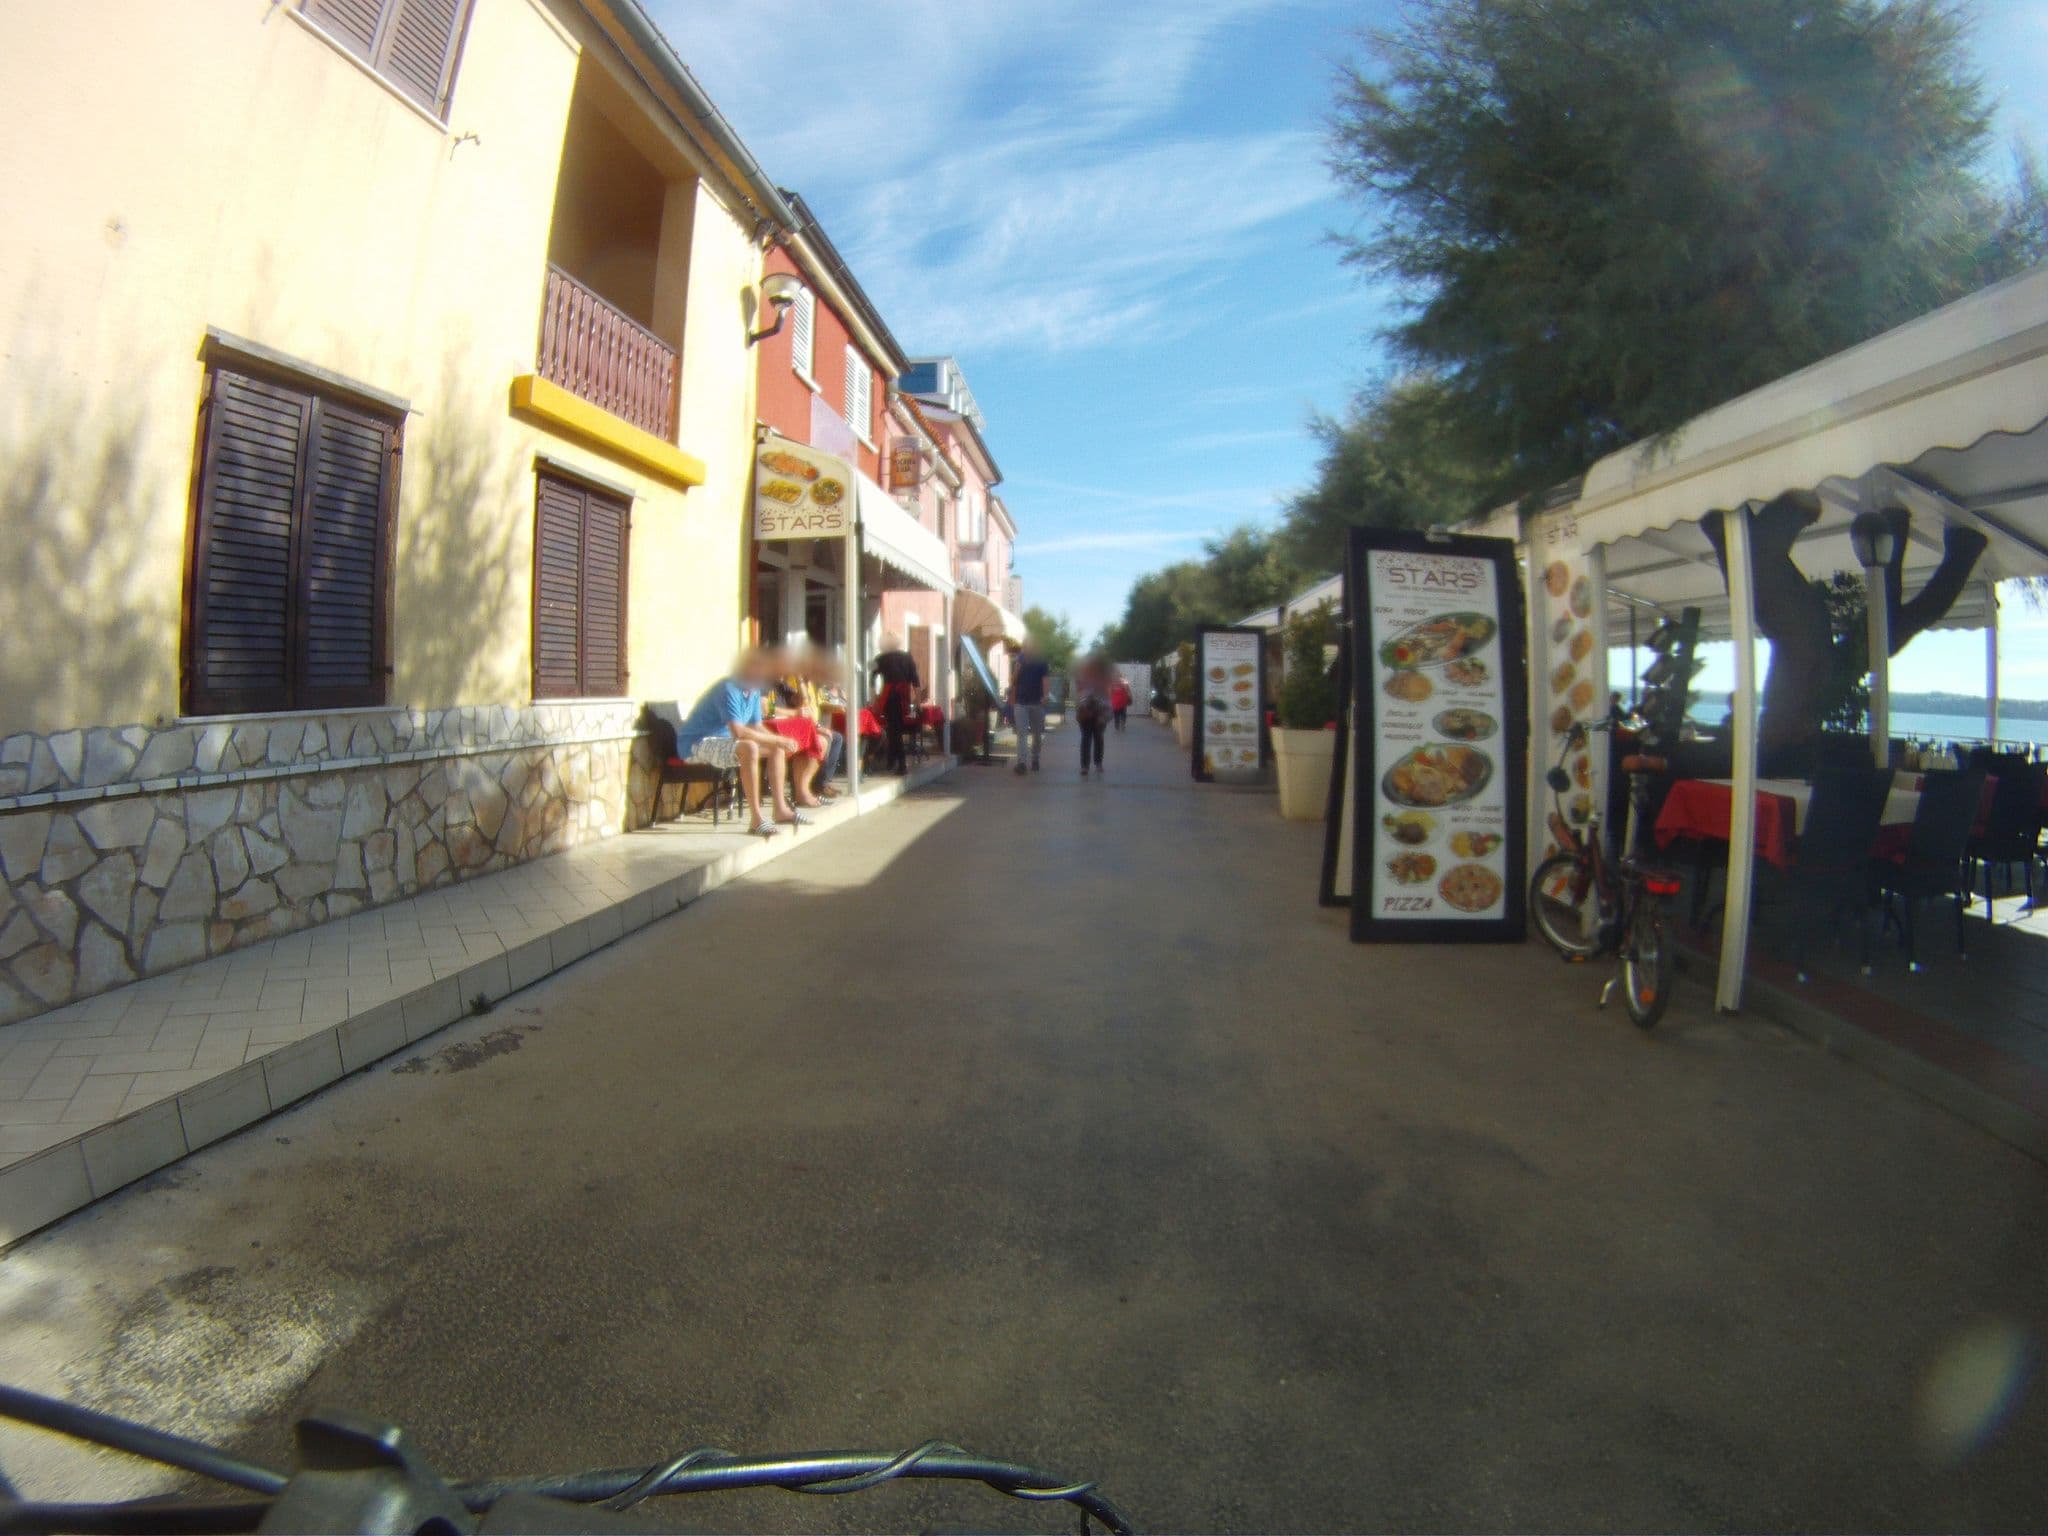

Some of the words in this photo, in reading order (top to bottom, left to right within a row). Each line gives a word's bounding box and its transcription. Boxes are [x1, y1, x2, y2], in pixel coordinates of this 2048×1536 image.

[760, 514, 842, 532] STARS
[1389, 567, 1478, 589] STARS
[1383, 896, 1433, 912] PIZZA
